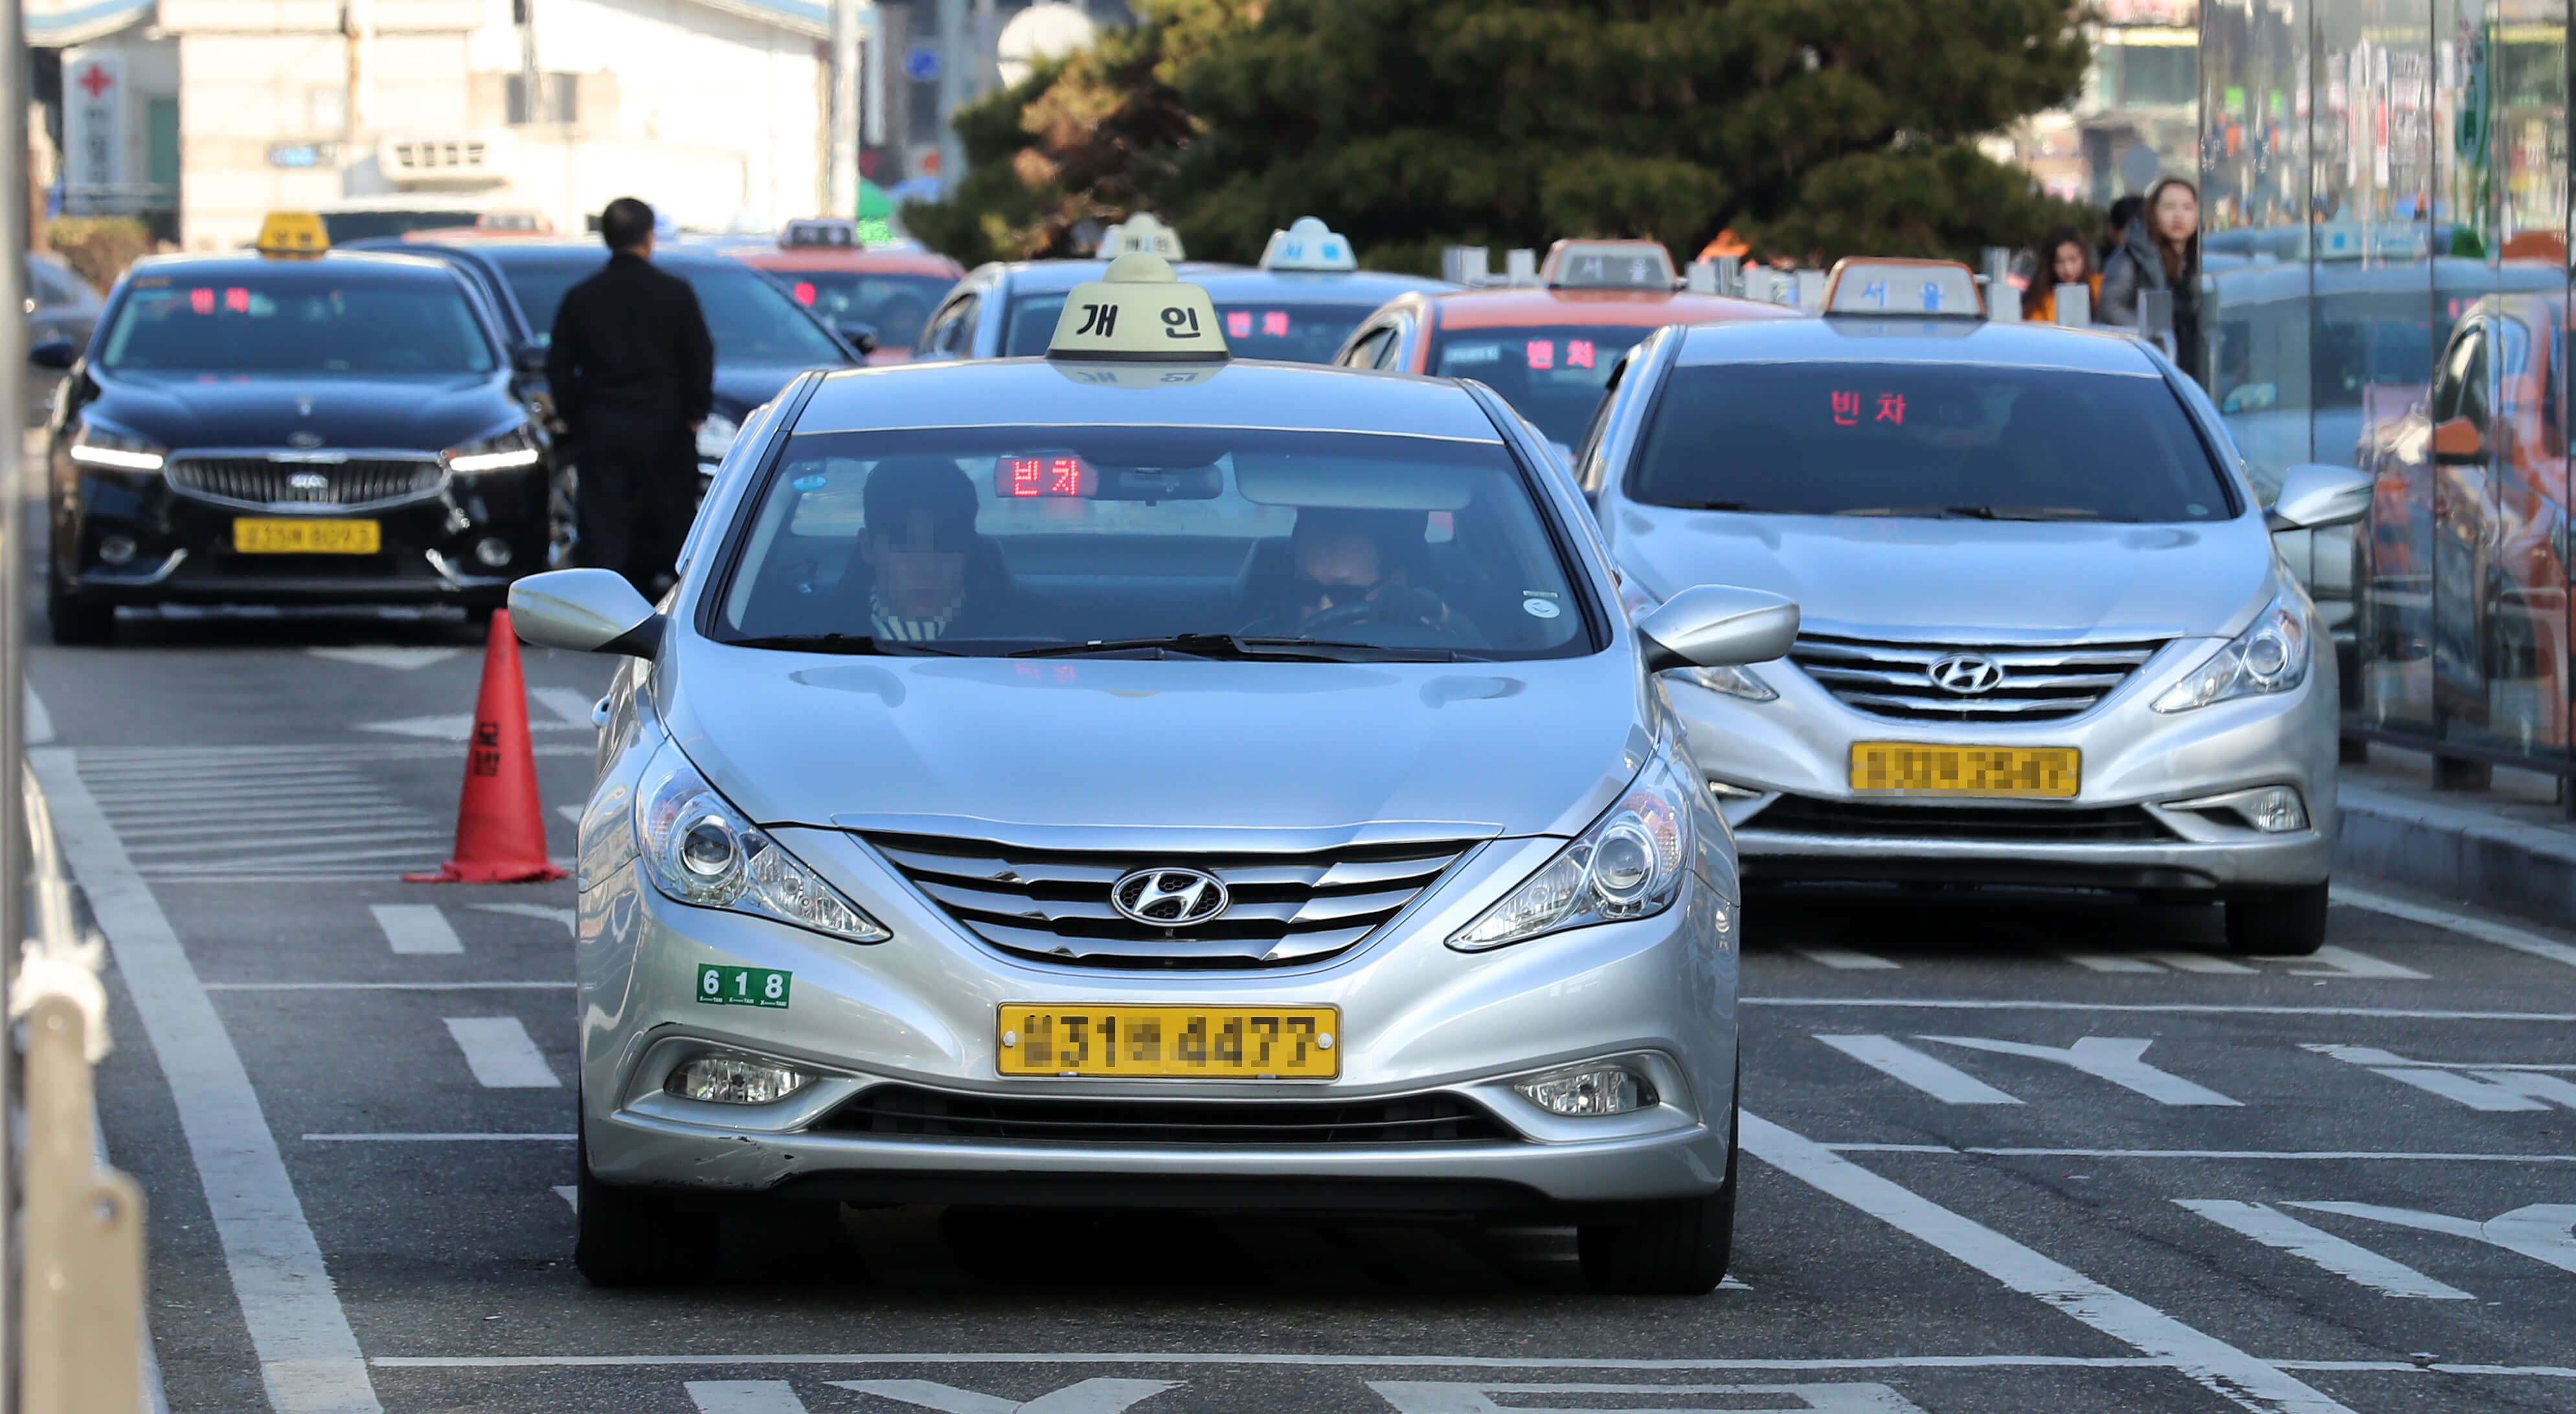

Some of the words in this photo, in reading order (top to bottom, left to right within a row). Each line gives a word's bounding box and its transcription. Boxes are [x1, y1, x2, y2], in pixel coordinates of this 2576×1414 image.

[1860, 280, 1945, 313] 서울
[1076, 303, 1201, 339] 개인
[1831, 390, 1907, 426] 빈차
[1013, 459, 1081, 497] 빈차
